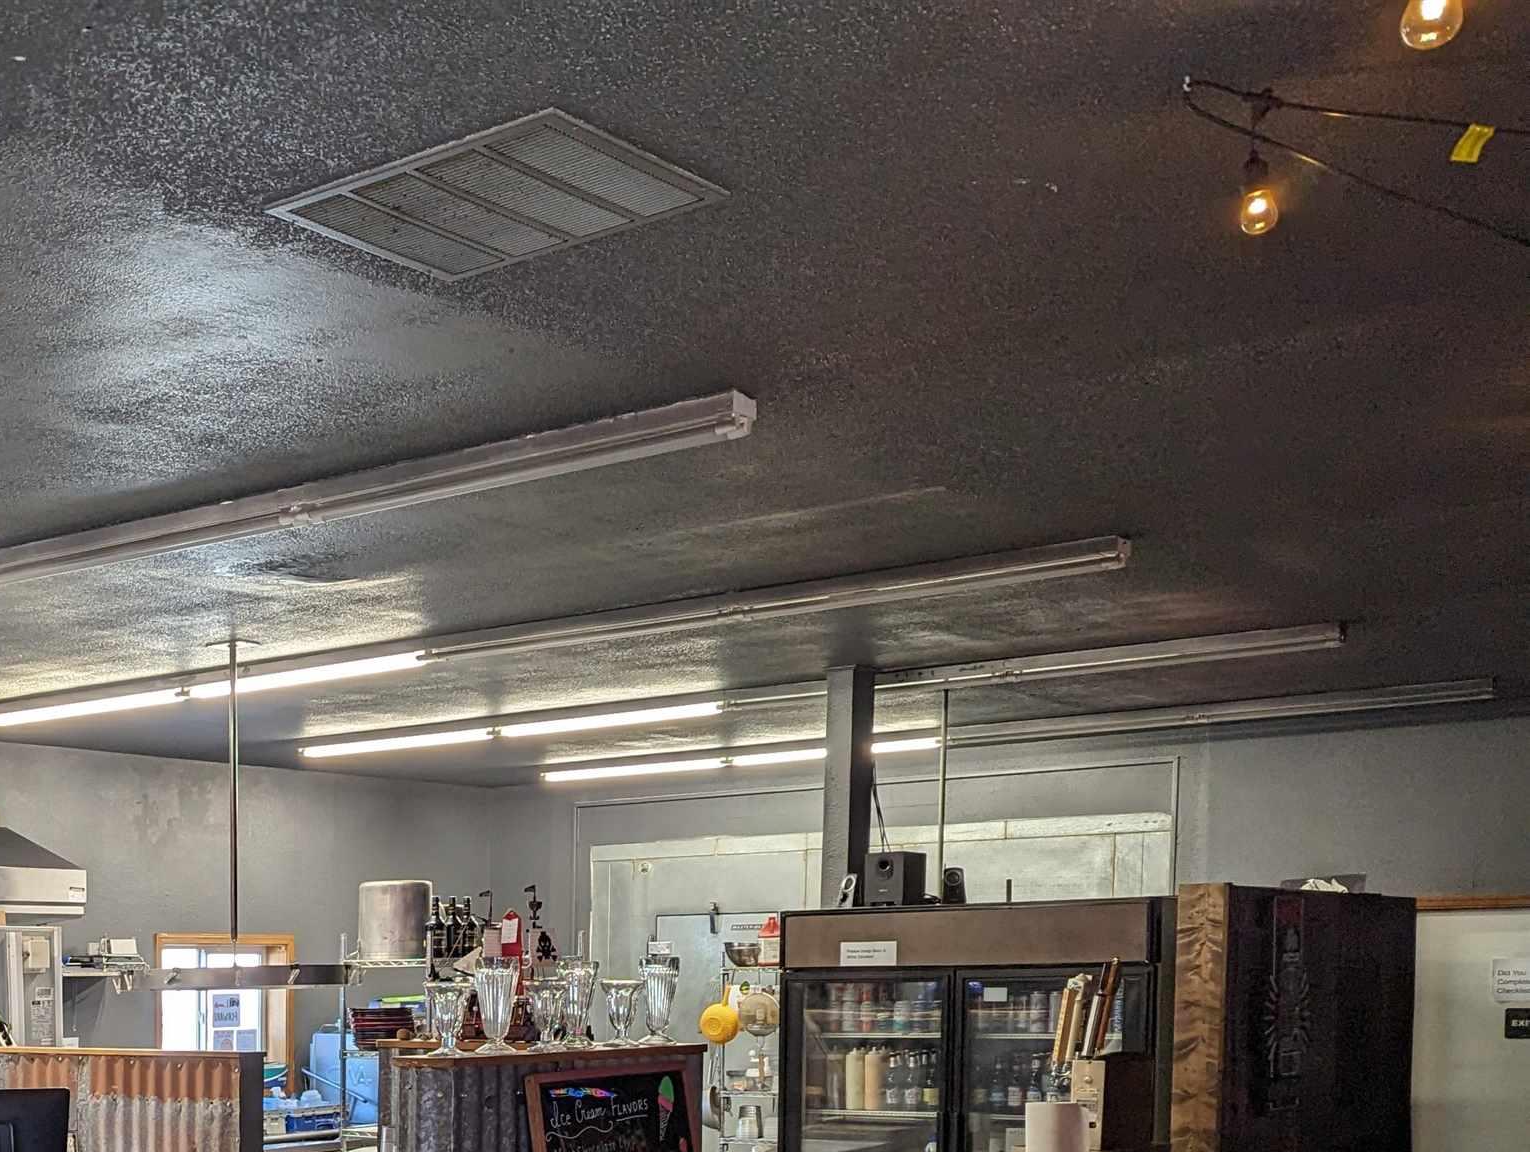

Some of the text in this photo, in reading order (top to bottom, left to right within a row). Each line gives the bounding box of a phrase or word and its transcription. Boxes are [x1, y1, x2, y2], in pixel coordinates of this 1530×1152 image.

[550, 1096, 649, 1128] Ice Cream FLAVORS
